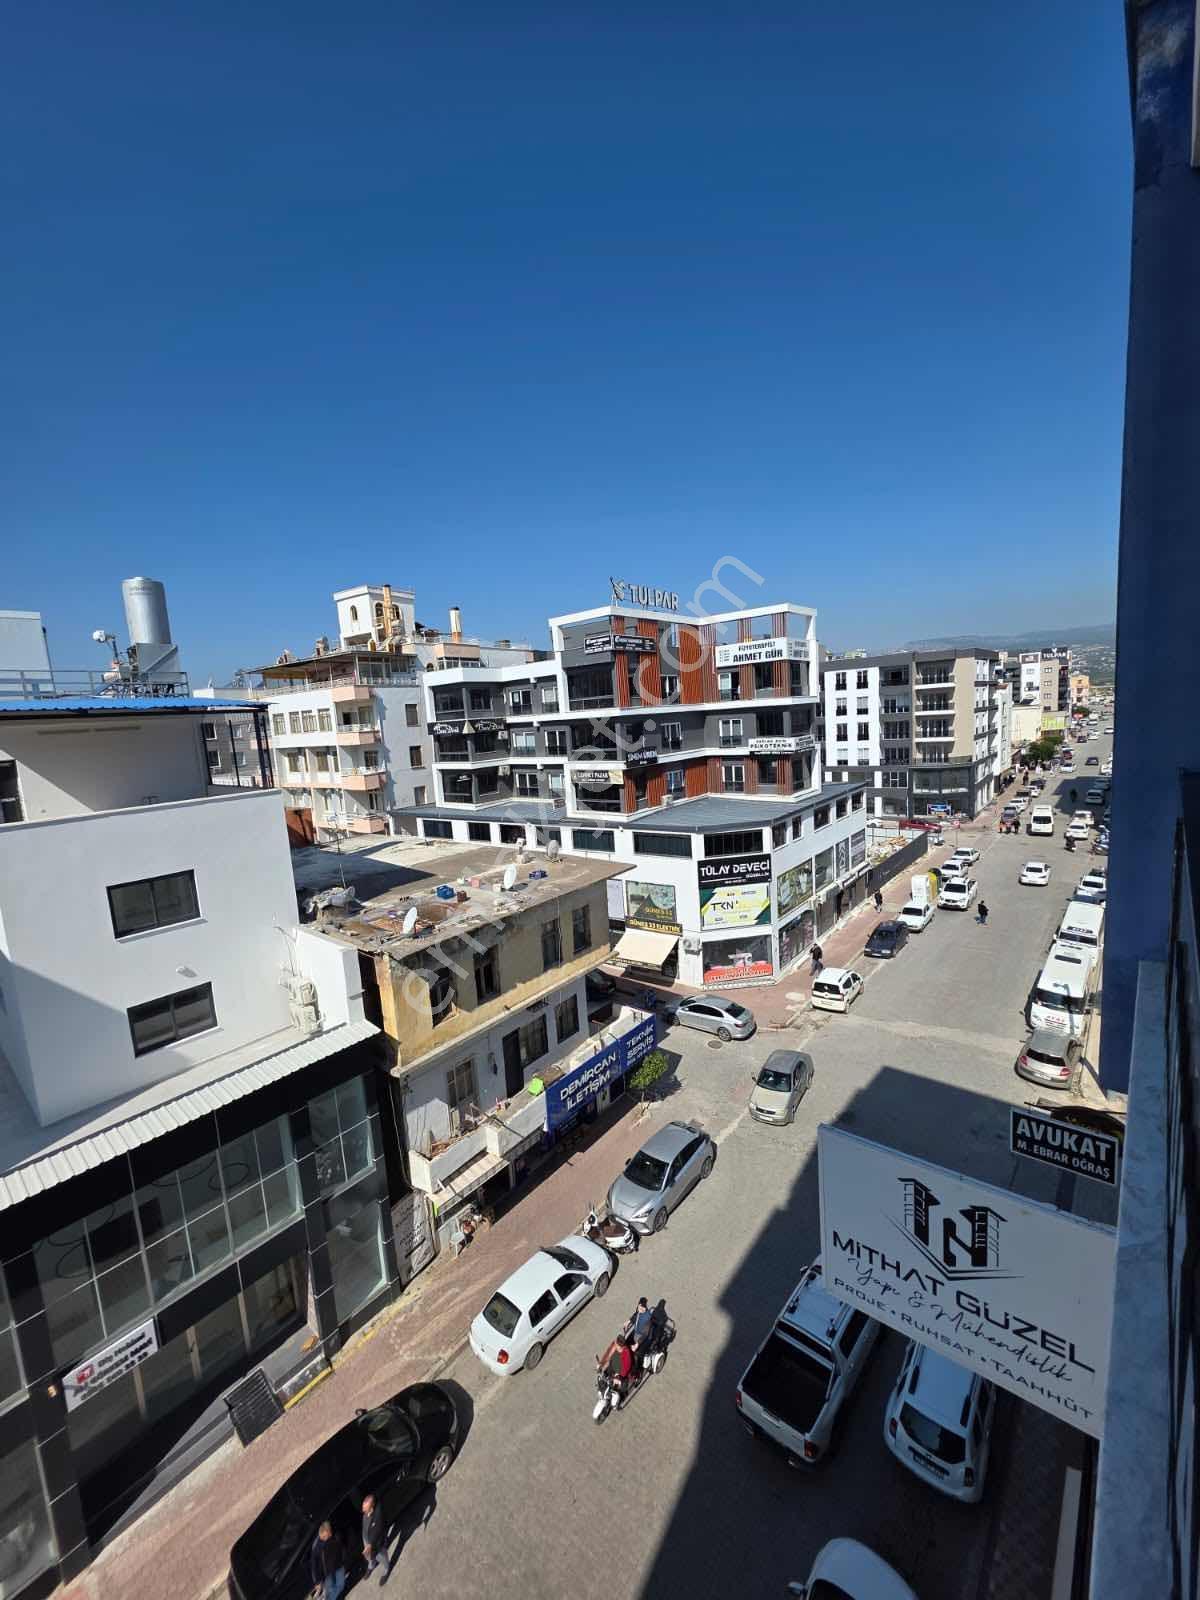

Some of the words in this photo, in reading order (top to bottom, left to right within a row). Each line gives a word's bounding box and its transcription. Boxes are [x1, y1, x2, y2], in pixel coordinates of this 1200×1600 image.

[630, 584, 679, 610] TULPAR
[733, 651, 762, 663] AHMET
[700, 864, 730, 877] TÜLAY
[732, 859, 770, 874] DEVECİ
[625, 1024, 655, 1049] TEKNİK
[627, 1035, 655, 1060] SERVİS
[560, 1052, 617, 1101] DEMİRCAN
[566, 1070, 611, 1111] İLETİŞİM
[1016, 1118, 1112, 1161] AVUKAT
[1017, 1140, 1032, 1152] M.
[1033, 1145, 1069, 1164] EBRAR
[1071, 1155, 1111, 1179] OĞRAŞ
[833, 1230, 945, 1297] MİTHAT
[955, 1290, 1096, 1373] GÜZEL
[834, 1277, 890, 1313] PROJE
[900, 1312, 975, 1357] RUHSAT
[991, 1357, 1095, 1421] TAAHHÜT
[908, 1290, 927, 1309] &
[930, 1303, 1074, 1384] Mühendislik
